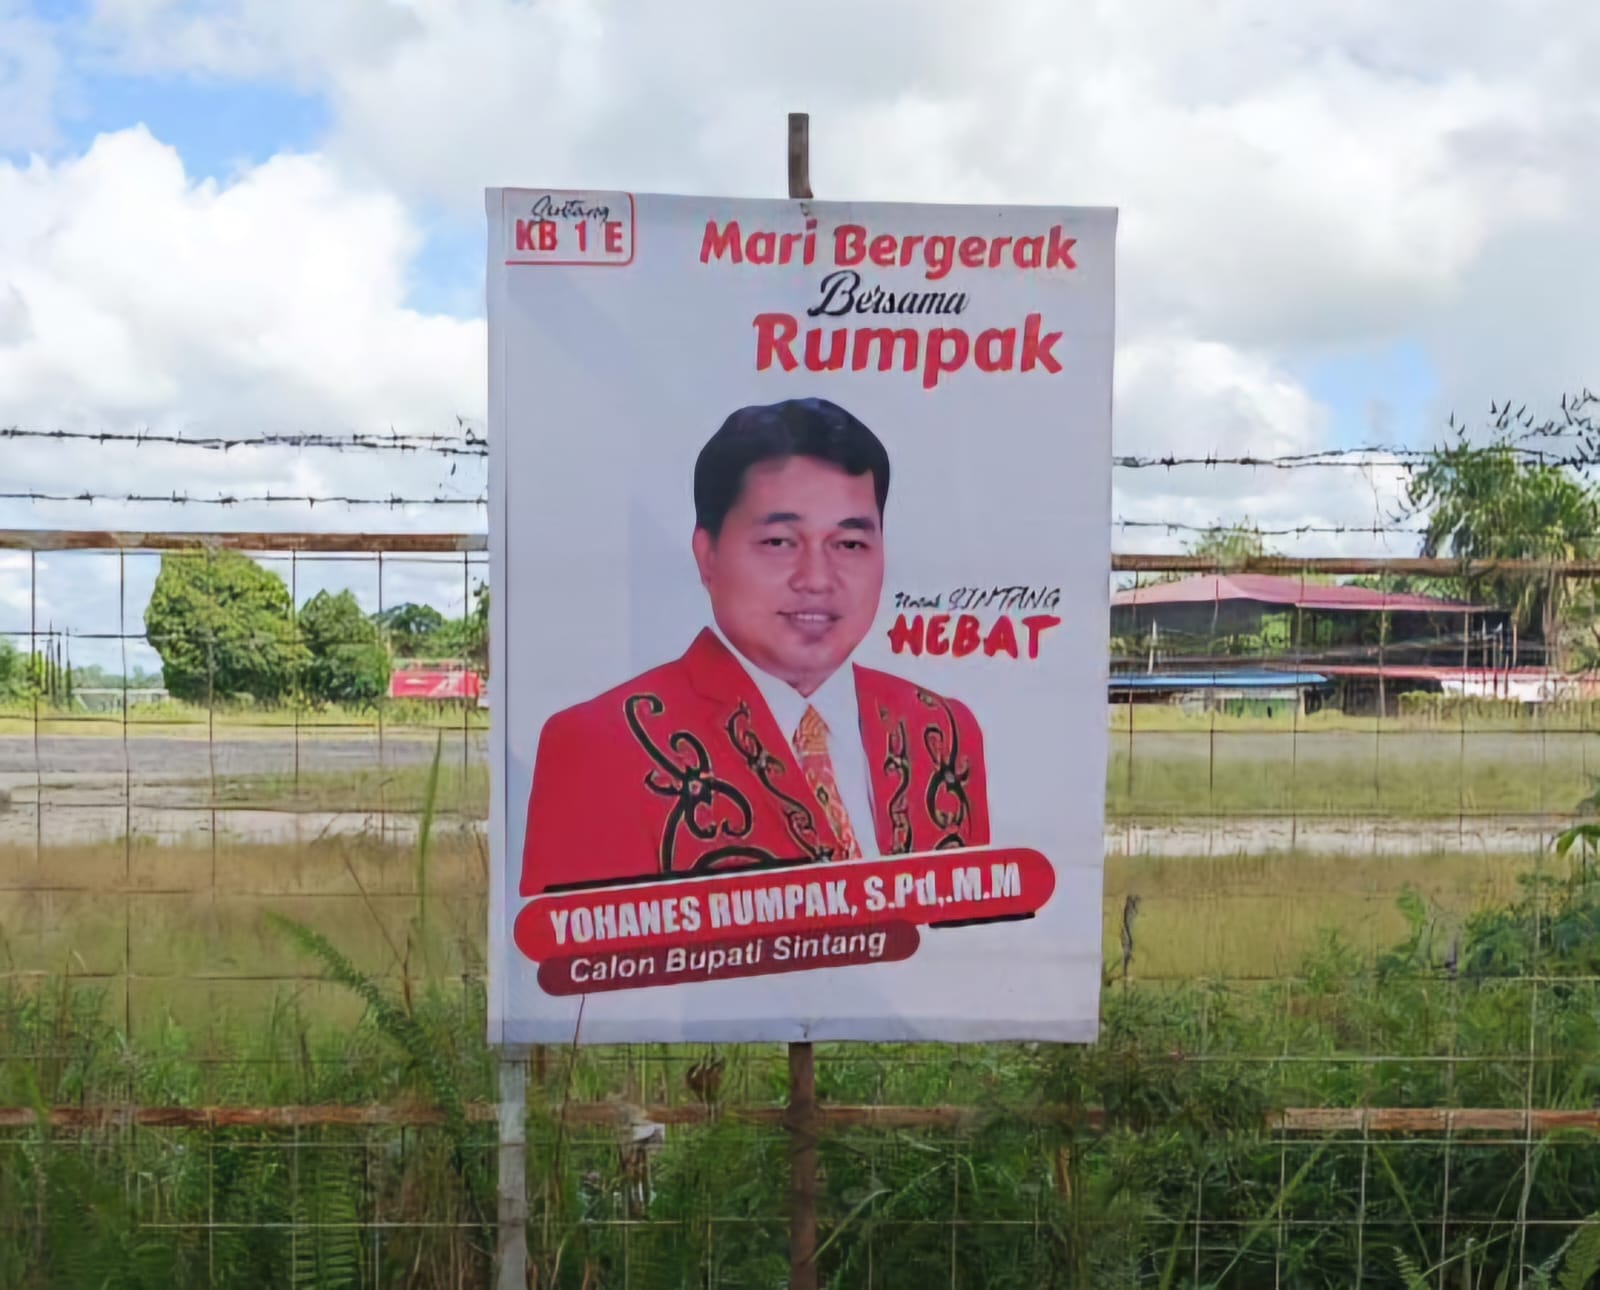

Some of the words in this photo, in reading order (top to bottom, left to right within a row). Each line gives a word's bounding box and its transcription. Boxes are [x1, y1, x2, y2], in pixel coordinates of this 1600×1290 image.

[516, 219, 558, 251] KB
[574, 219, 587, 252] 1
[605, 221, 623, 253] E
[700, 218, 818, 266] Mari
[833, 224, 1078, 281] Bergerak
[807, 269, 969, 317] Bersama
[752, 312, 1064, 390] Rumpak
[887, 613, 1061, 660] HEBAT
[550, 896, 701, 945] YOHANES
[708, 879, 858, 928] RUMPAK,
[570, 955, 655, 983] Calon
[665, 938, 763, 975] Bupati
[772, 931, 887, 960] Sintang
